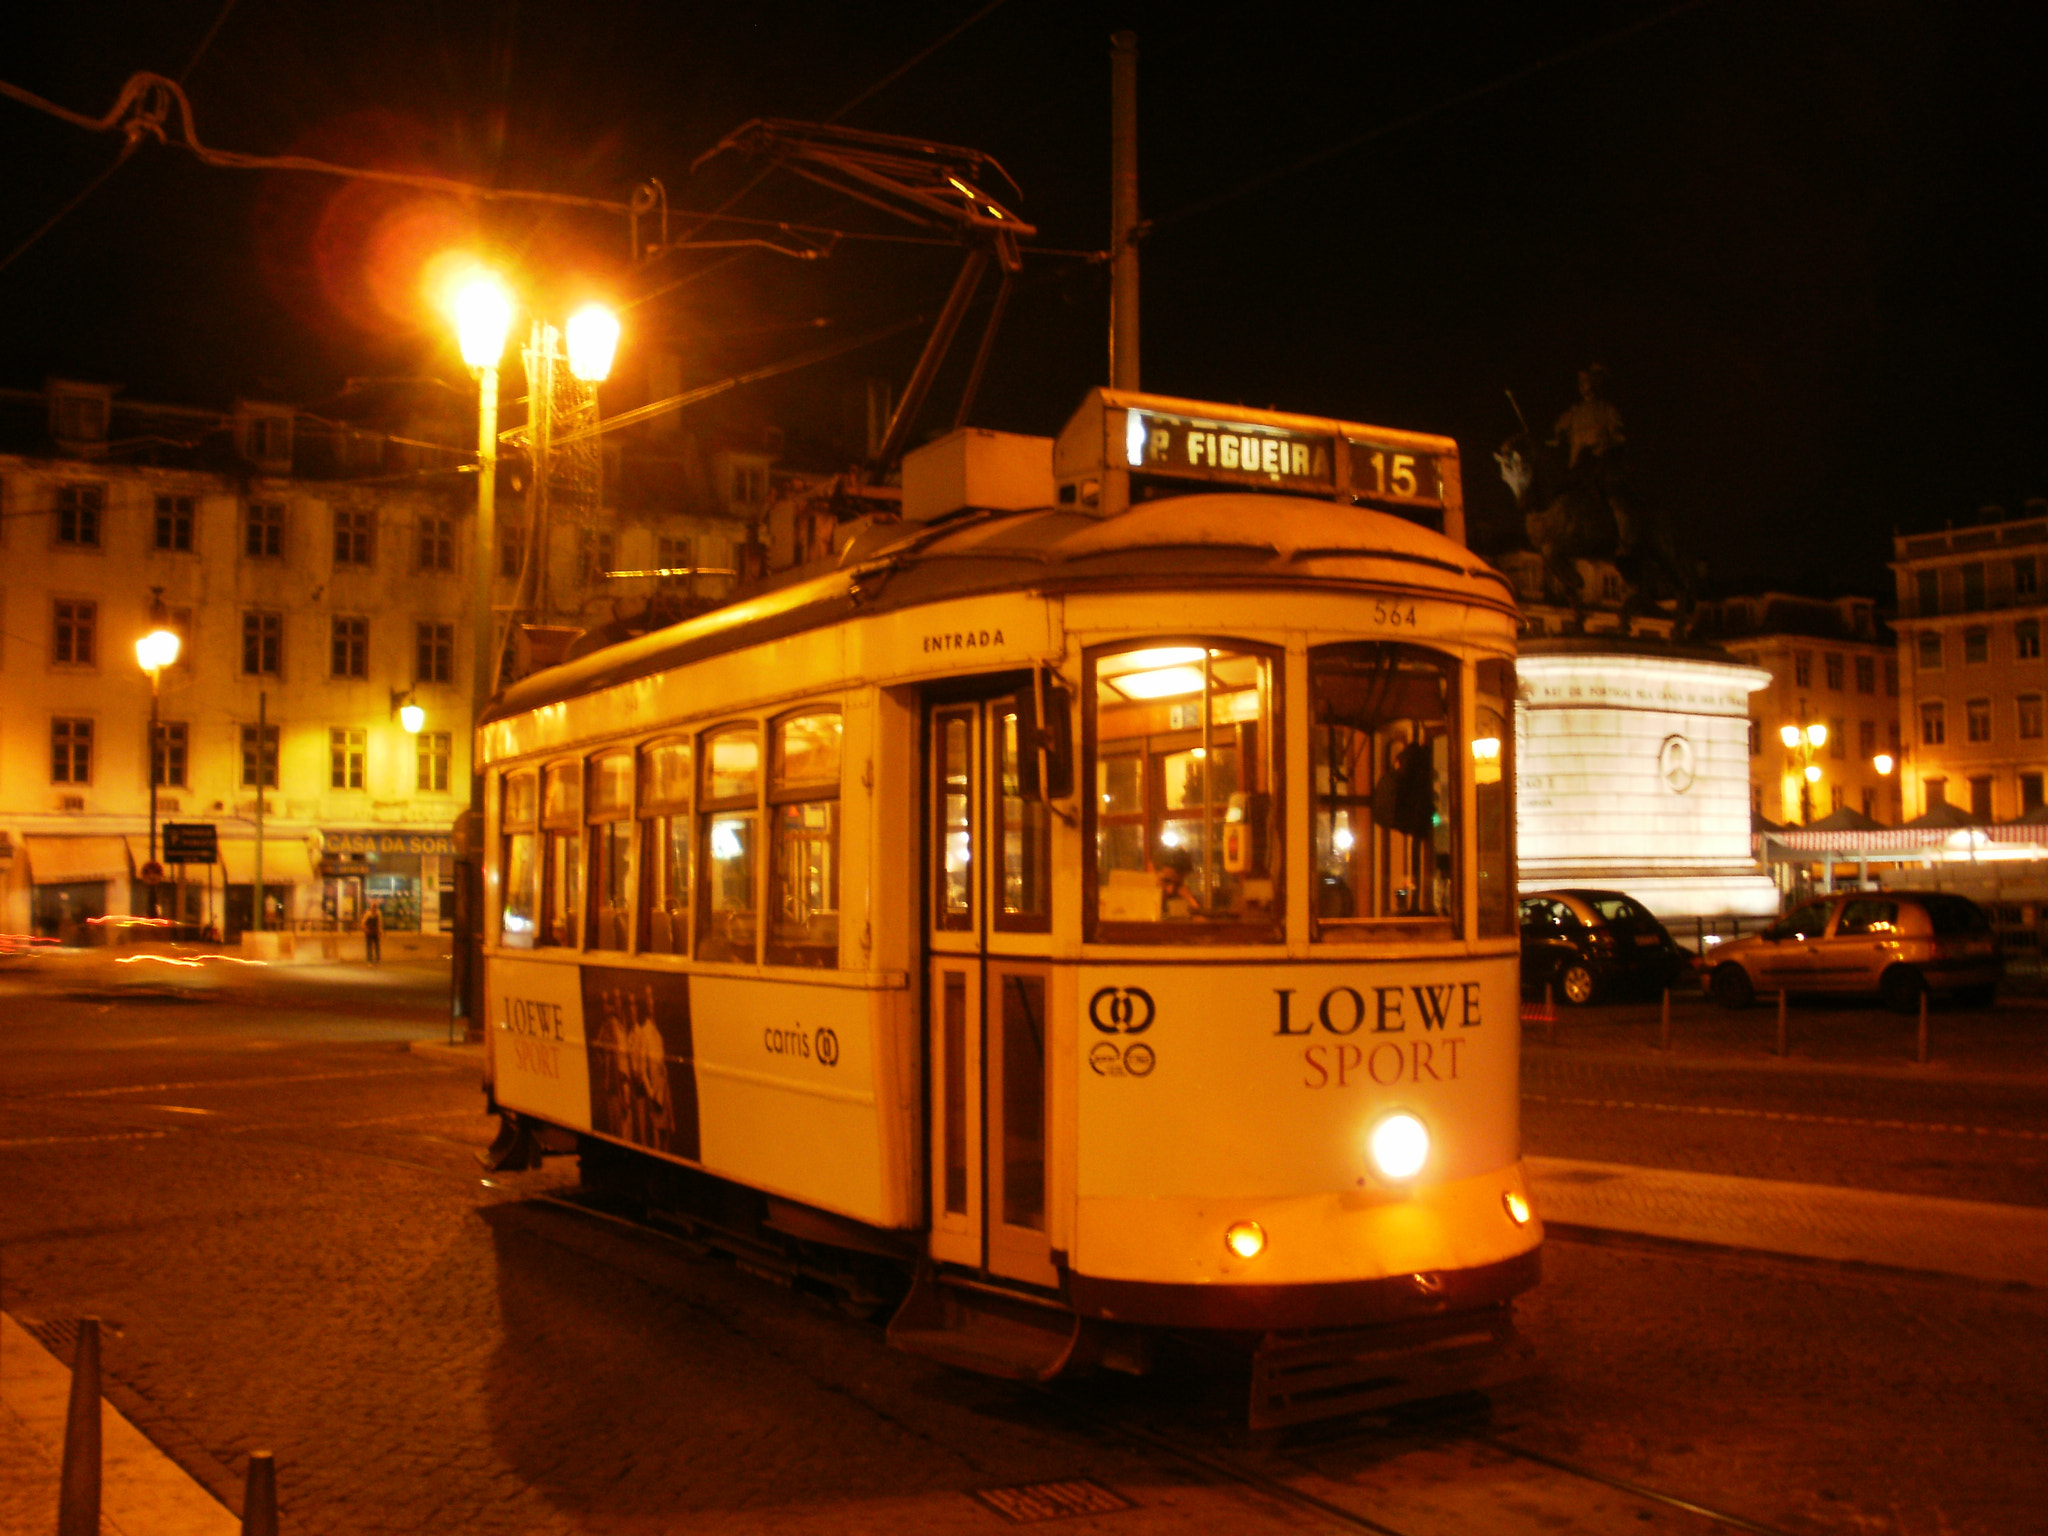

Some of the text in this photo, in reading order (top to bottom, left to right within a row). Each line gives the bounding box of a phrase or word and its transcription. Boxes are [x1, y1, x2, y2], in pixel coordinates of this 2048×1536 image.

[1150, 428, 1330, 477] P. FIGUEIRA
[1370, 452, 1417, 498] 15
[1374, 599, 1416, 627] 564
[923, 630, 1005, 652] ENTRADA
[326, 835, 376, 854] CASA
[381, 836, 405, 854] DA
[504, 996, 564, 1041] LOEWE
[1273, 982, 1482, 1036] LOEWE
[514, 1039, 562, 1079] SPORT
[764, 1021, 810, 1058] carris
[1304, 1037, 1466, 1089] SPORT
